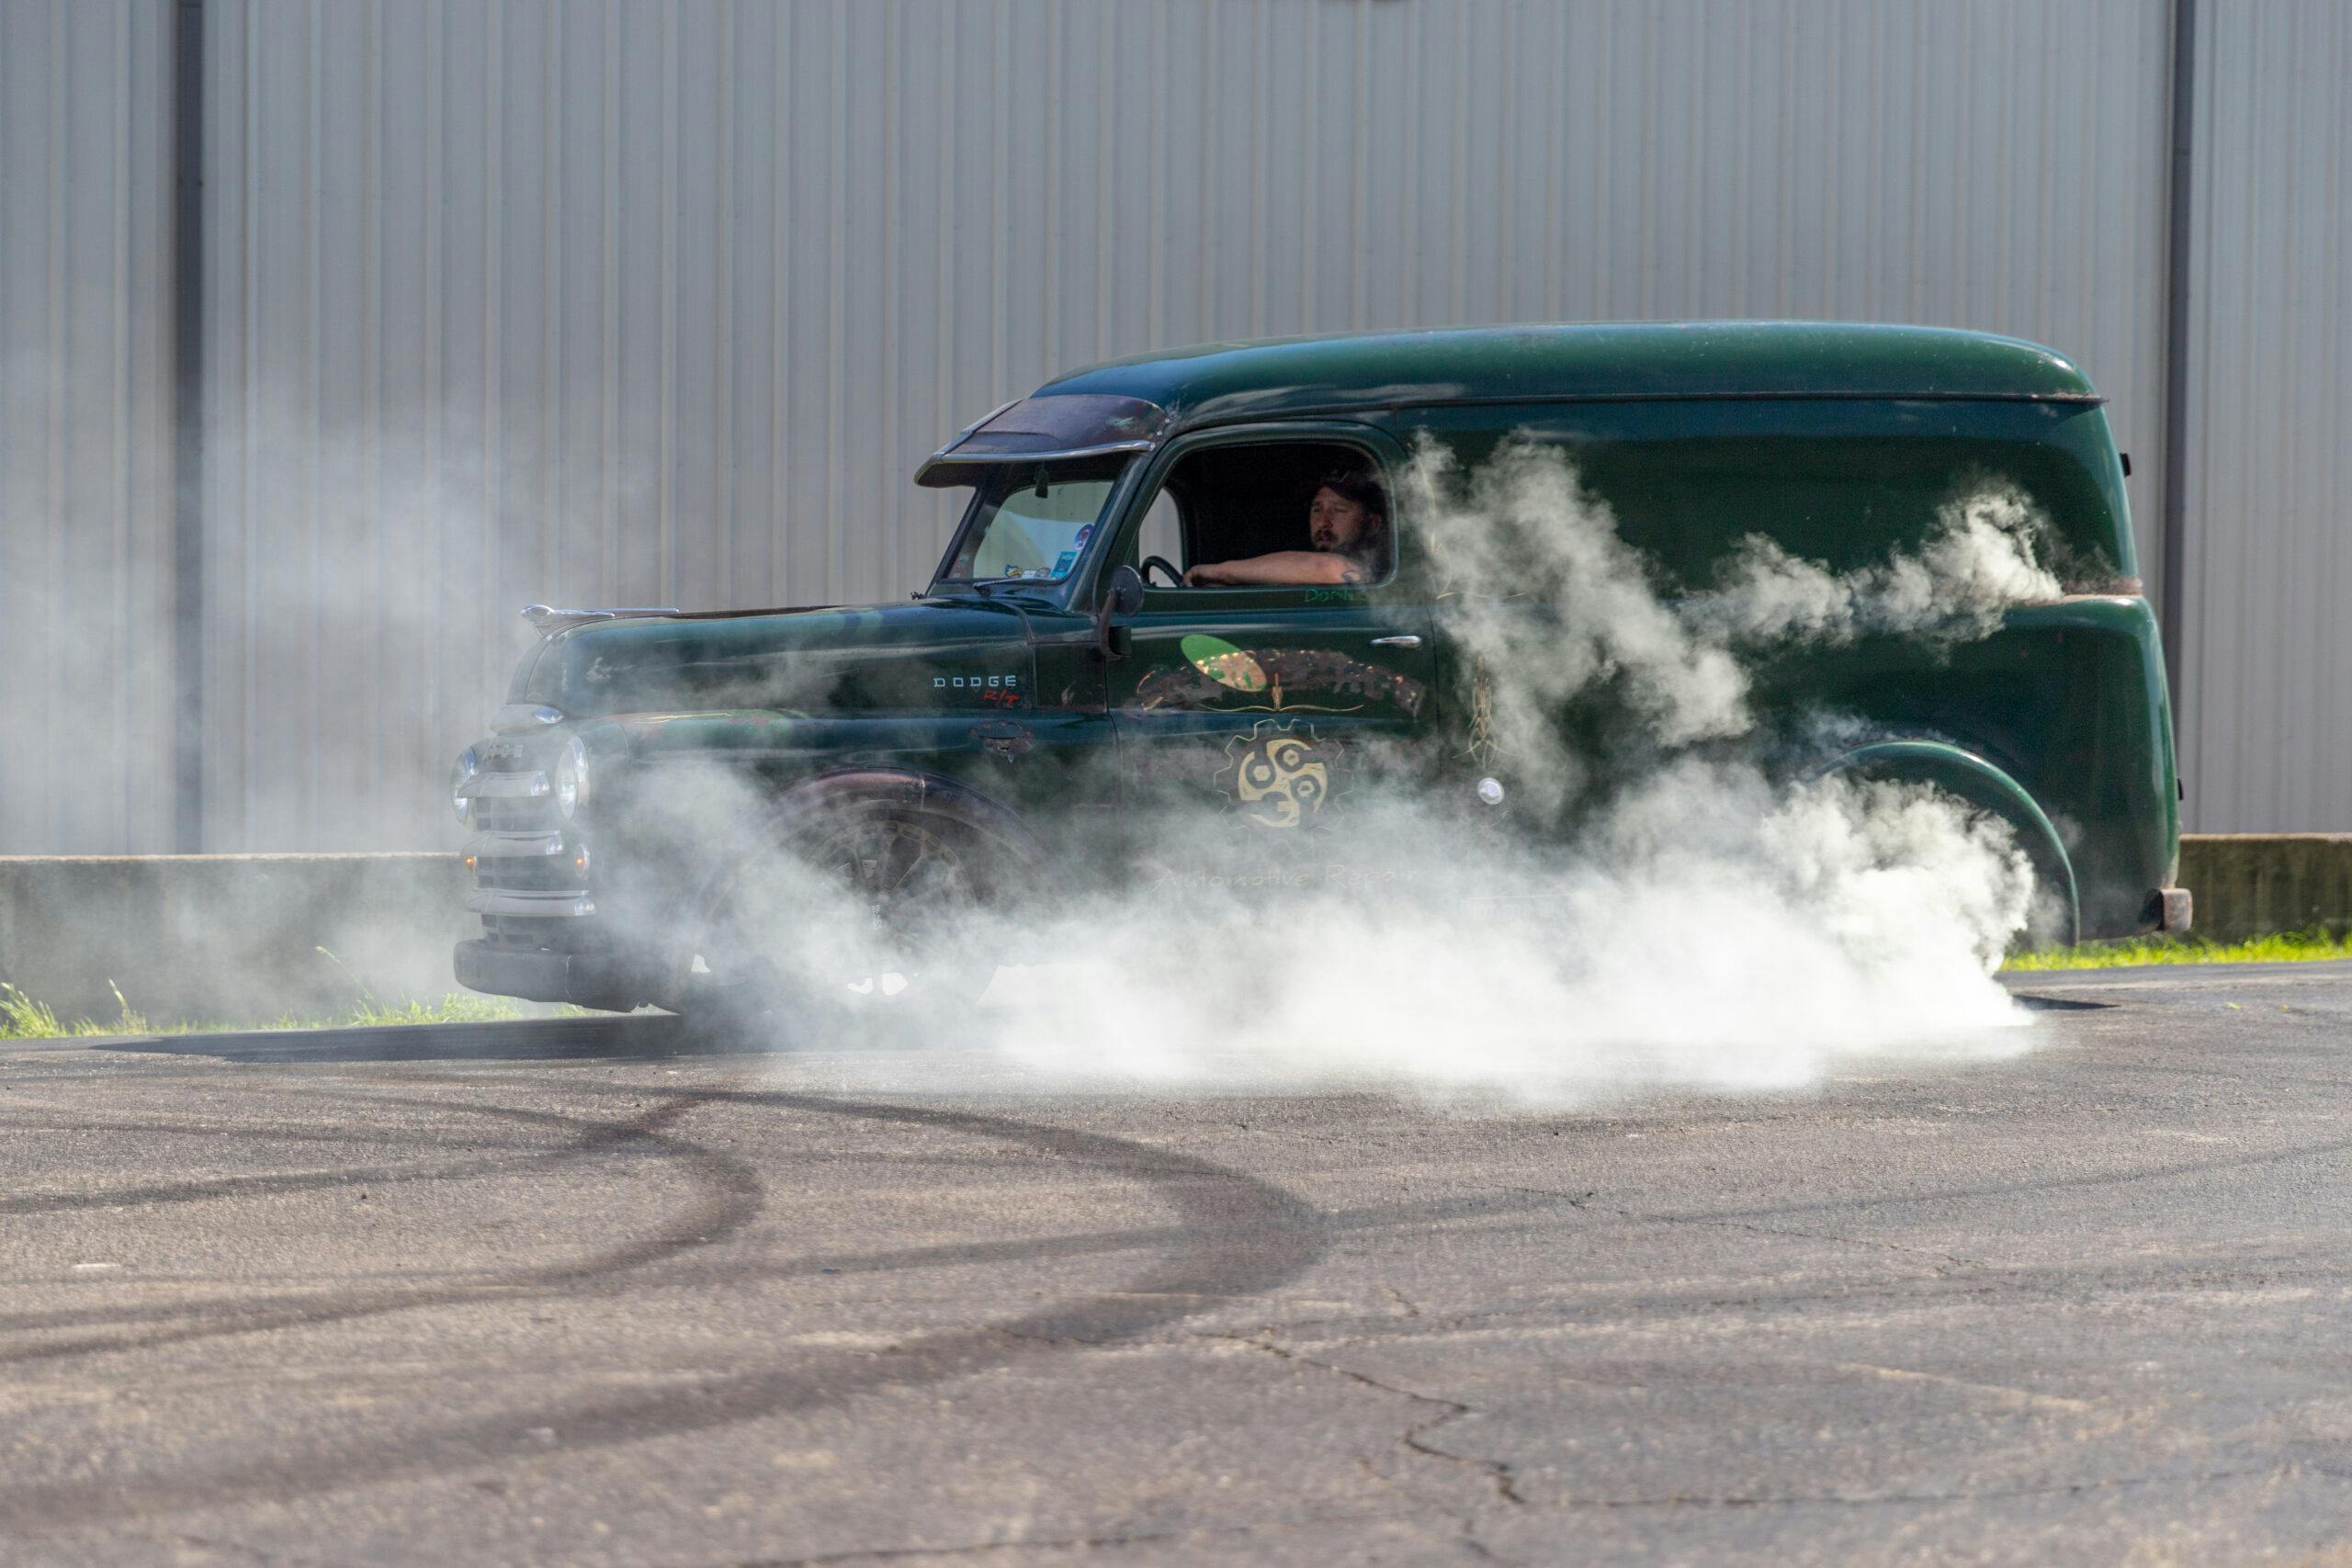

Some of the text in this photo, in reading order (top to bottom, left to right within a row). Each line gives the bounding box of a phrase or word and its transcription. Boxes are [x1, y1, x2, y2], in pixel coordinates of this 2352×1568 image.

[933, 675, 1016, 687] DODGE
[984, 688, 1020, 707] R/T
[1150, 868, 1308, 893] Automotive
